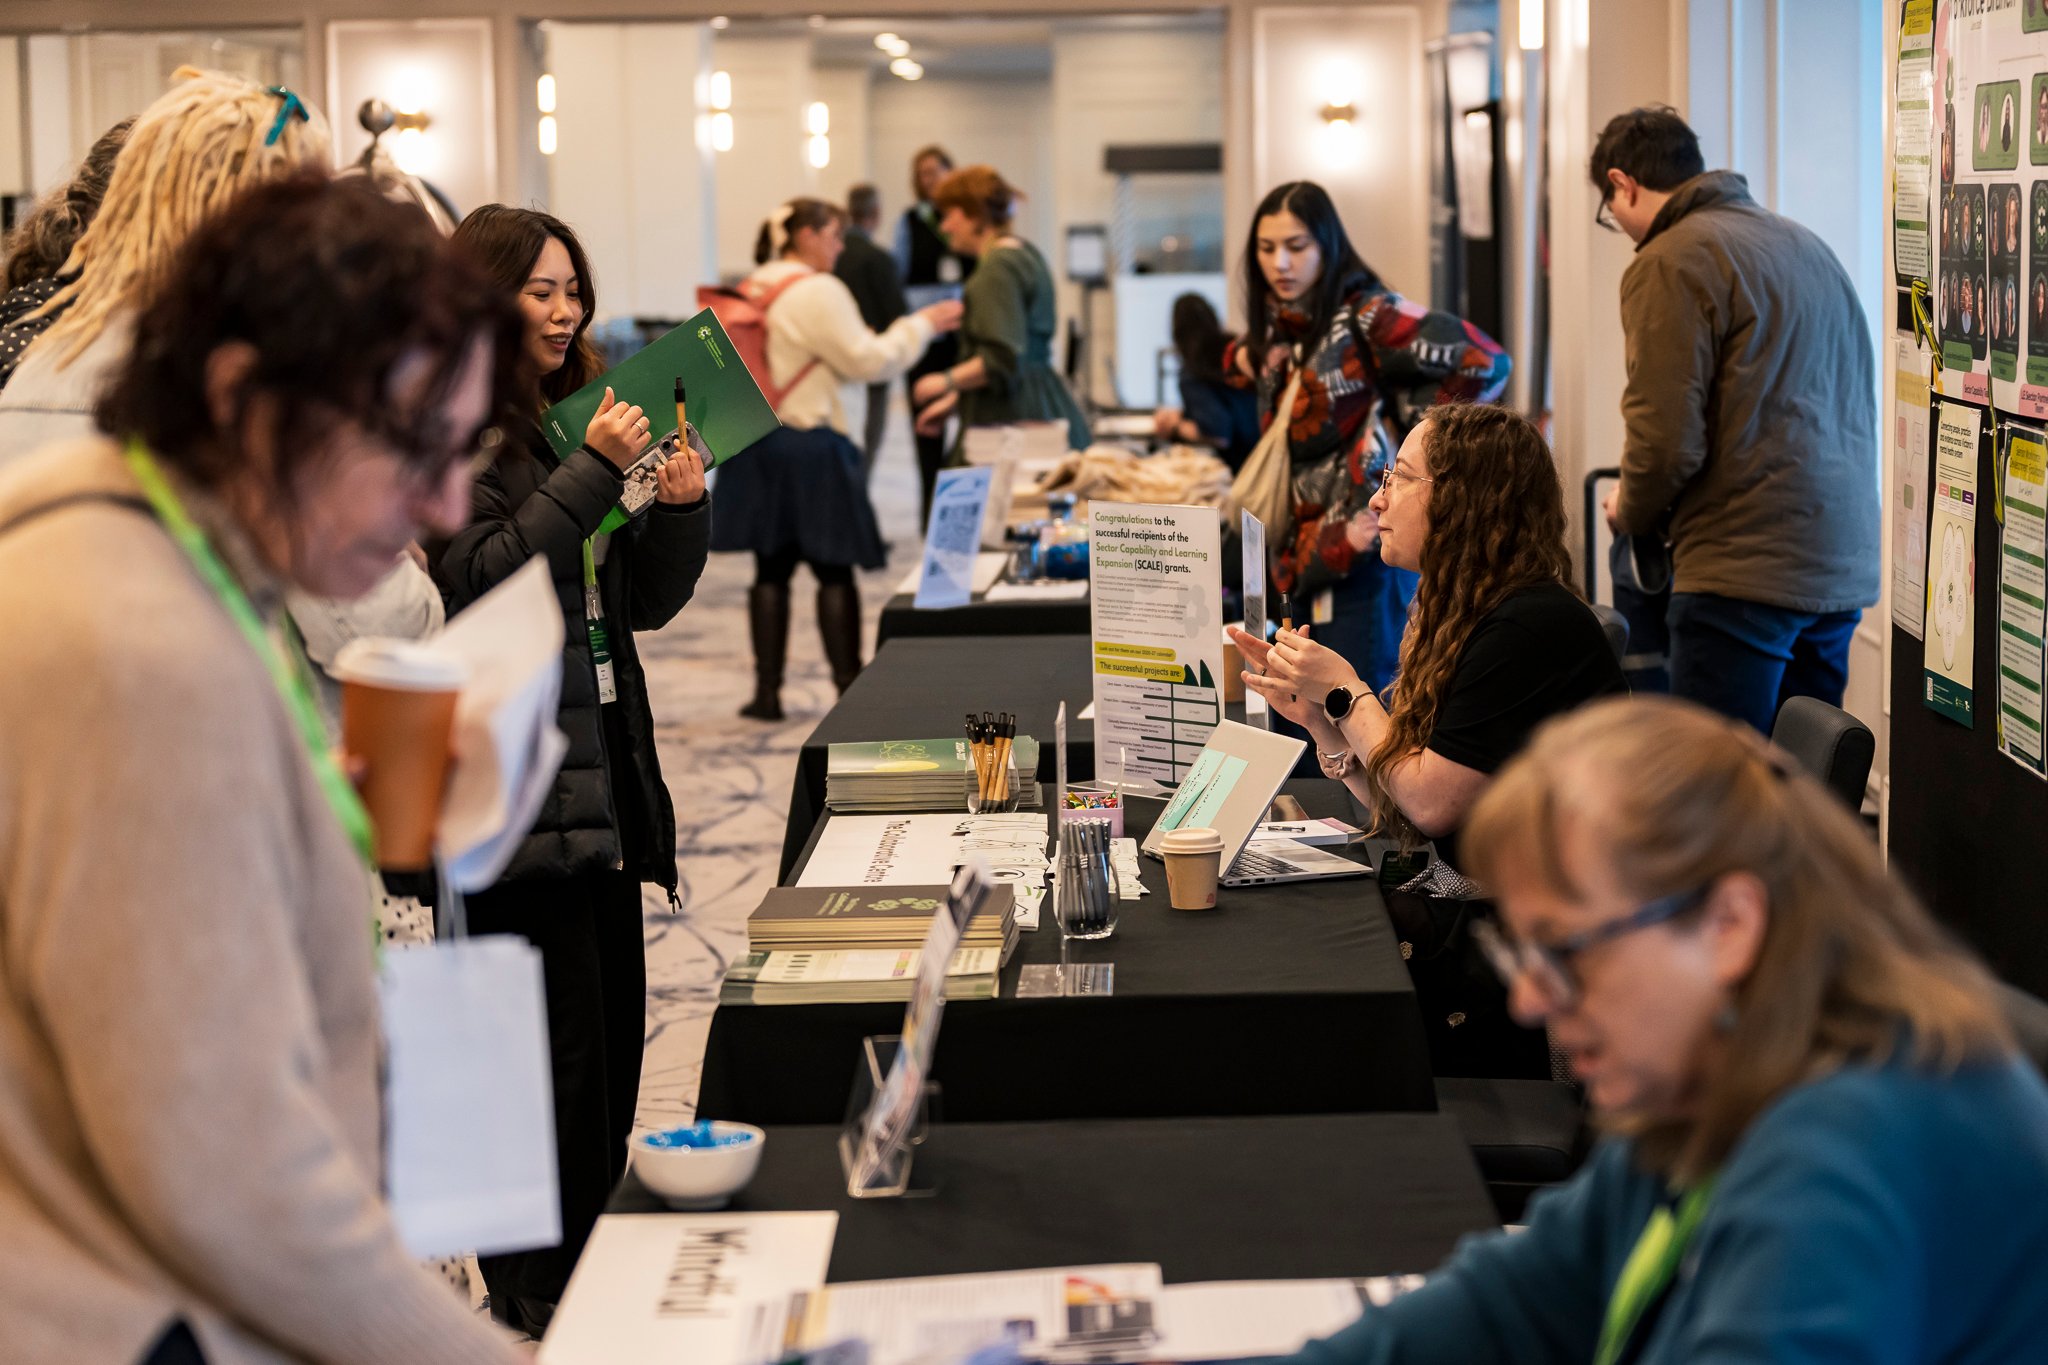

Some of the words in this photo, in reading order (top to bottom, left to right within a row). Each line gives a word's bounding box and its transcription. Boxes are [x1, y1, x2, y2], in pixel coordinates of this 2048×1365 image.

[1095, 512, 1152, 525] Congratulations
[1154, 516, 1162, 525] to
[1163, 516, 1176, 526] the
[1096, 528, 1130, 539] successful
[1132, 530, 1166, 542] recipients
[1168, 532, 1176, 542] of
[1177, 532, 1189, 542] the
[1096, 542, 1118, 552] Sector
[1120, 544, 1157, 558] Capability
[1159, 547, 1173, 556] and
[1175, 548, 1208, 561] Learning
[1096, 557, 1133, 569] Expansion
[1135, 559, 1163, 573] (SCALE)
[1165, 562, 1191, 574] grants.
[1113, 664, 1143, 673] successful
[1145, 667, 1168, 676] projects
